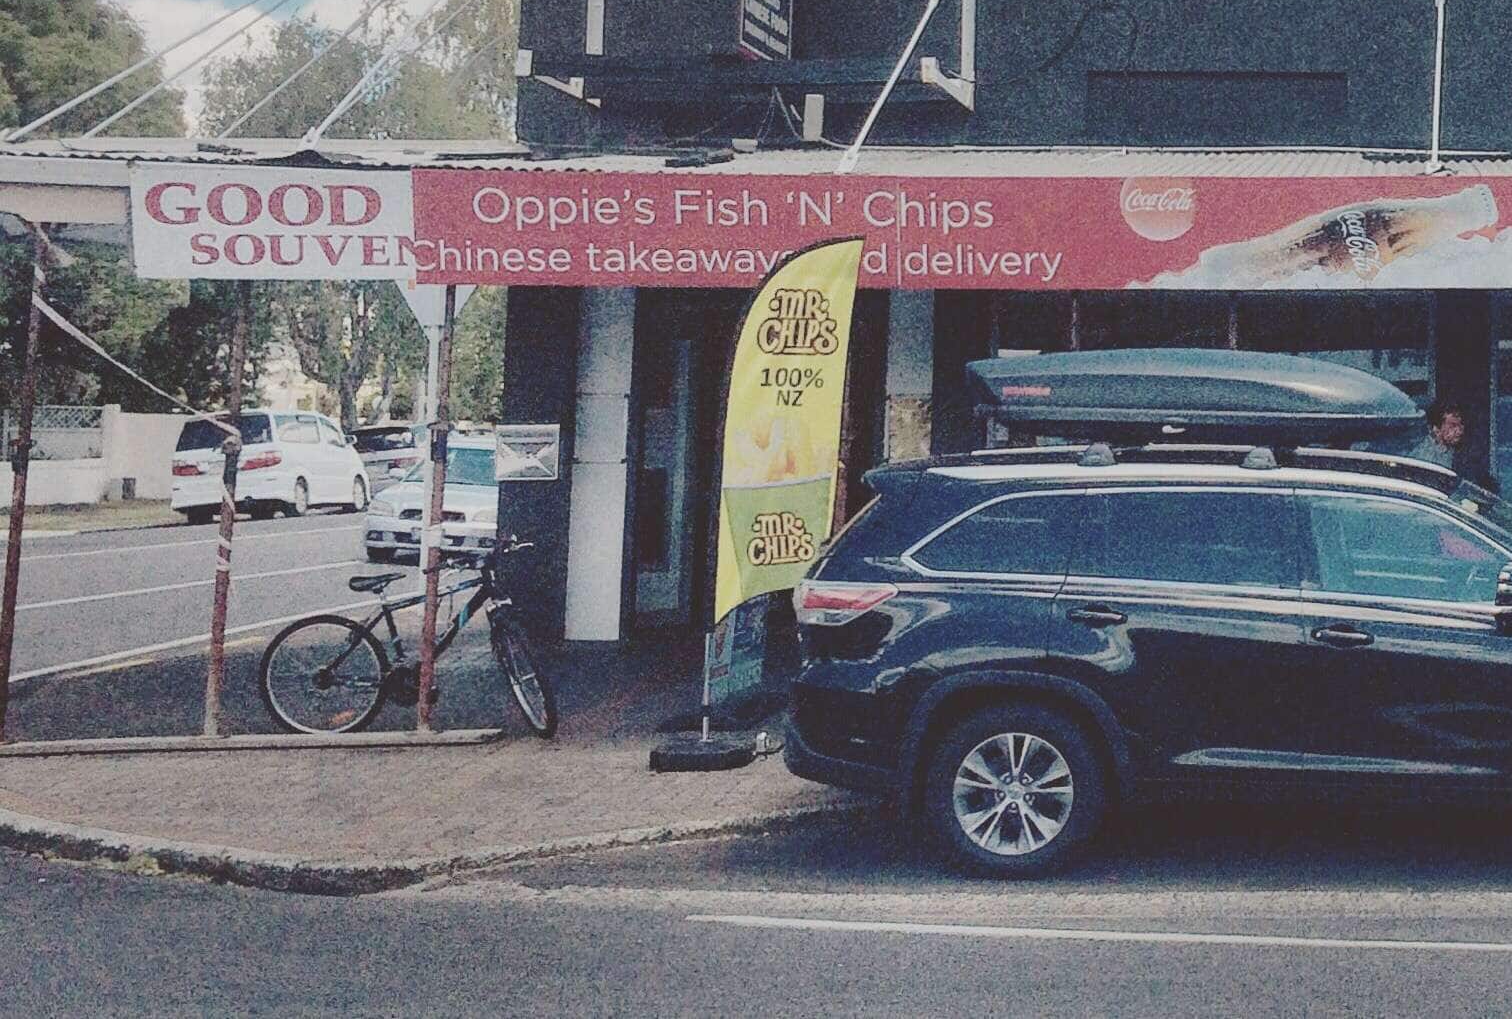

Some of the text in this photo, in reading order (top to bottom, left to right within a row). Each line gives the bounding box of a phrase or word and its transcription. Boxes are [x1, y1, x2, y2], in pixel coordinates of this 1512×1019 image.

[144, 182, 381, 226] GOOD
[472, 187, 656, 231] Oppie's
[674, 189, 768, 226] Fish
[863, 191, 994, 234] Chips
[414, 239, 571, 272] Chinese
[904, 243, 1062, 282] delivery
[757, 318, 839, 355] CHIPS
[760, 368, 824, 388] 100%
[776, 390, 804, 407] NZ
[747, 534, 815, 566] CHIPS
